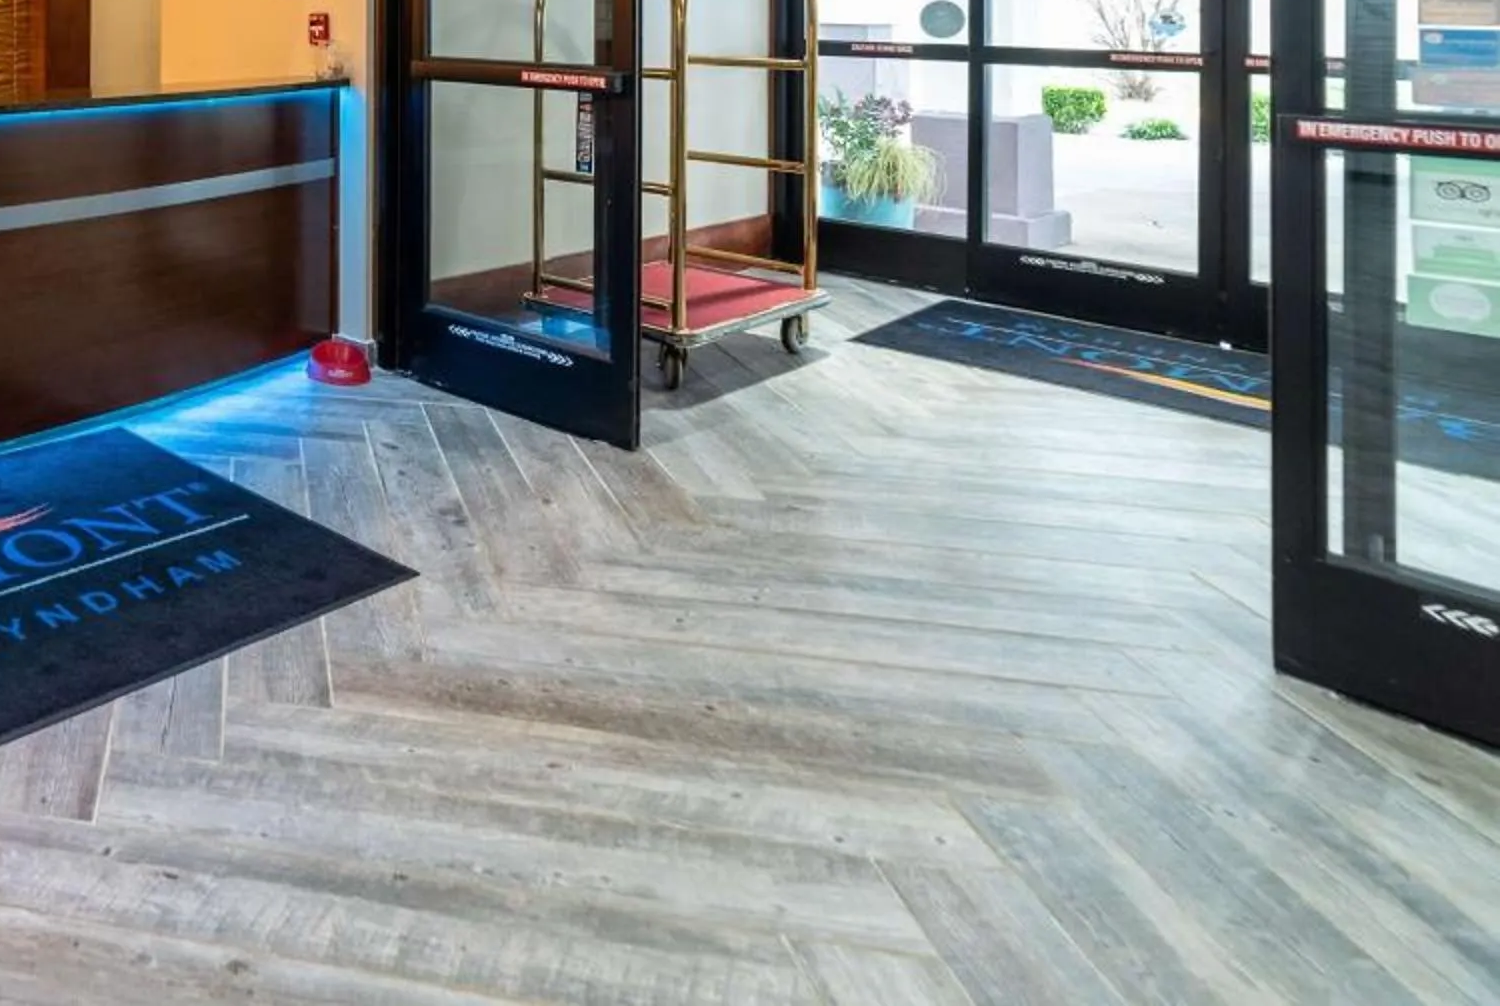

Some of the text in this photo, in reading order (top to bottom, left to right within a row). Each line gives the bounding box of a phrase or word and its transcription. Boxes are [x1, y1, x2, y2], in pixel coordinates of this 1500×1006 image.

[1297, 119, 1317, 138] IN
[1320, 121, 1411, 144] EMERGENCY
[1412, 128, 1456, 147] PUSH
[1459, 131, 1482, 149] TO
